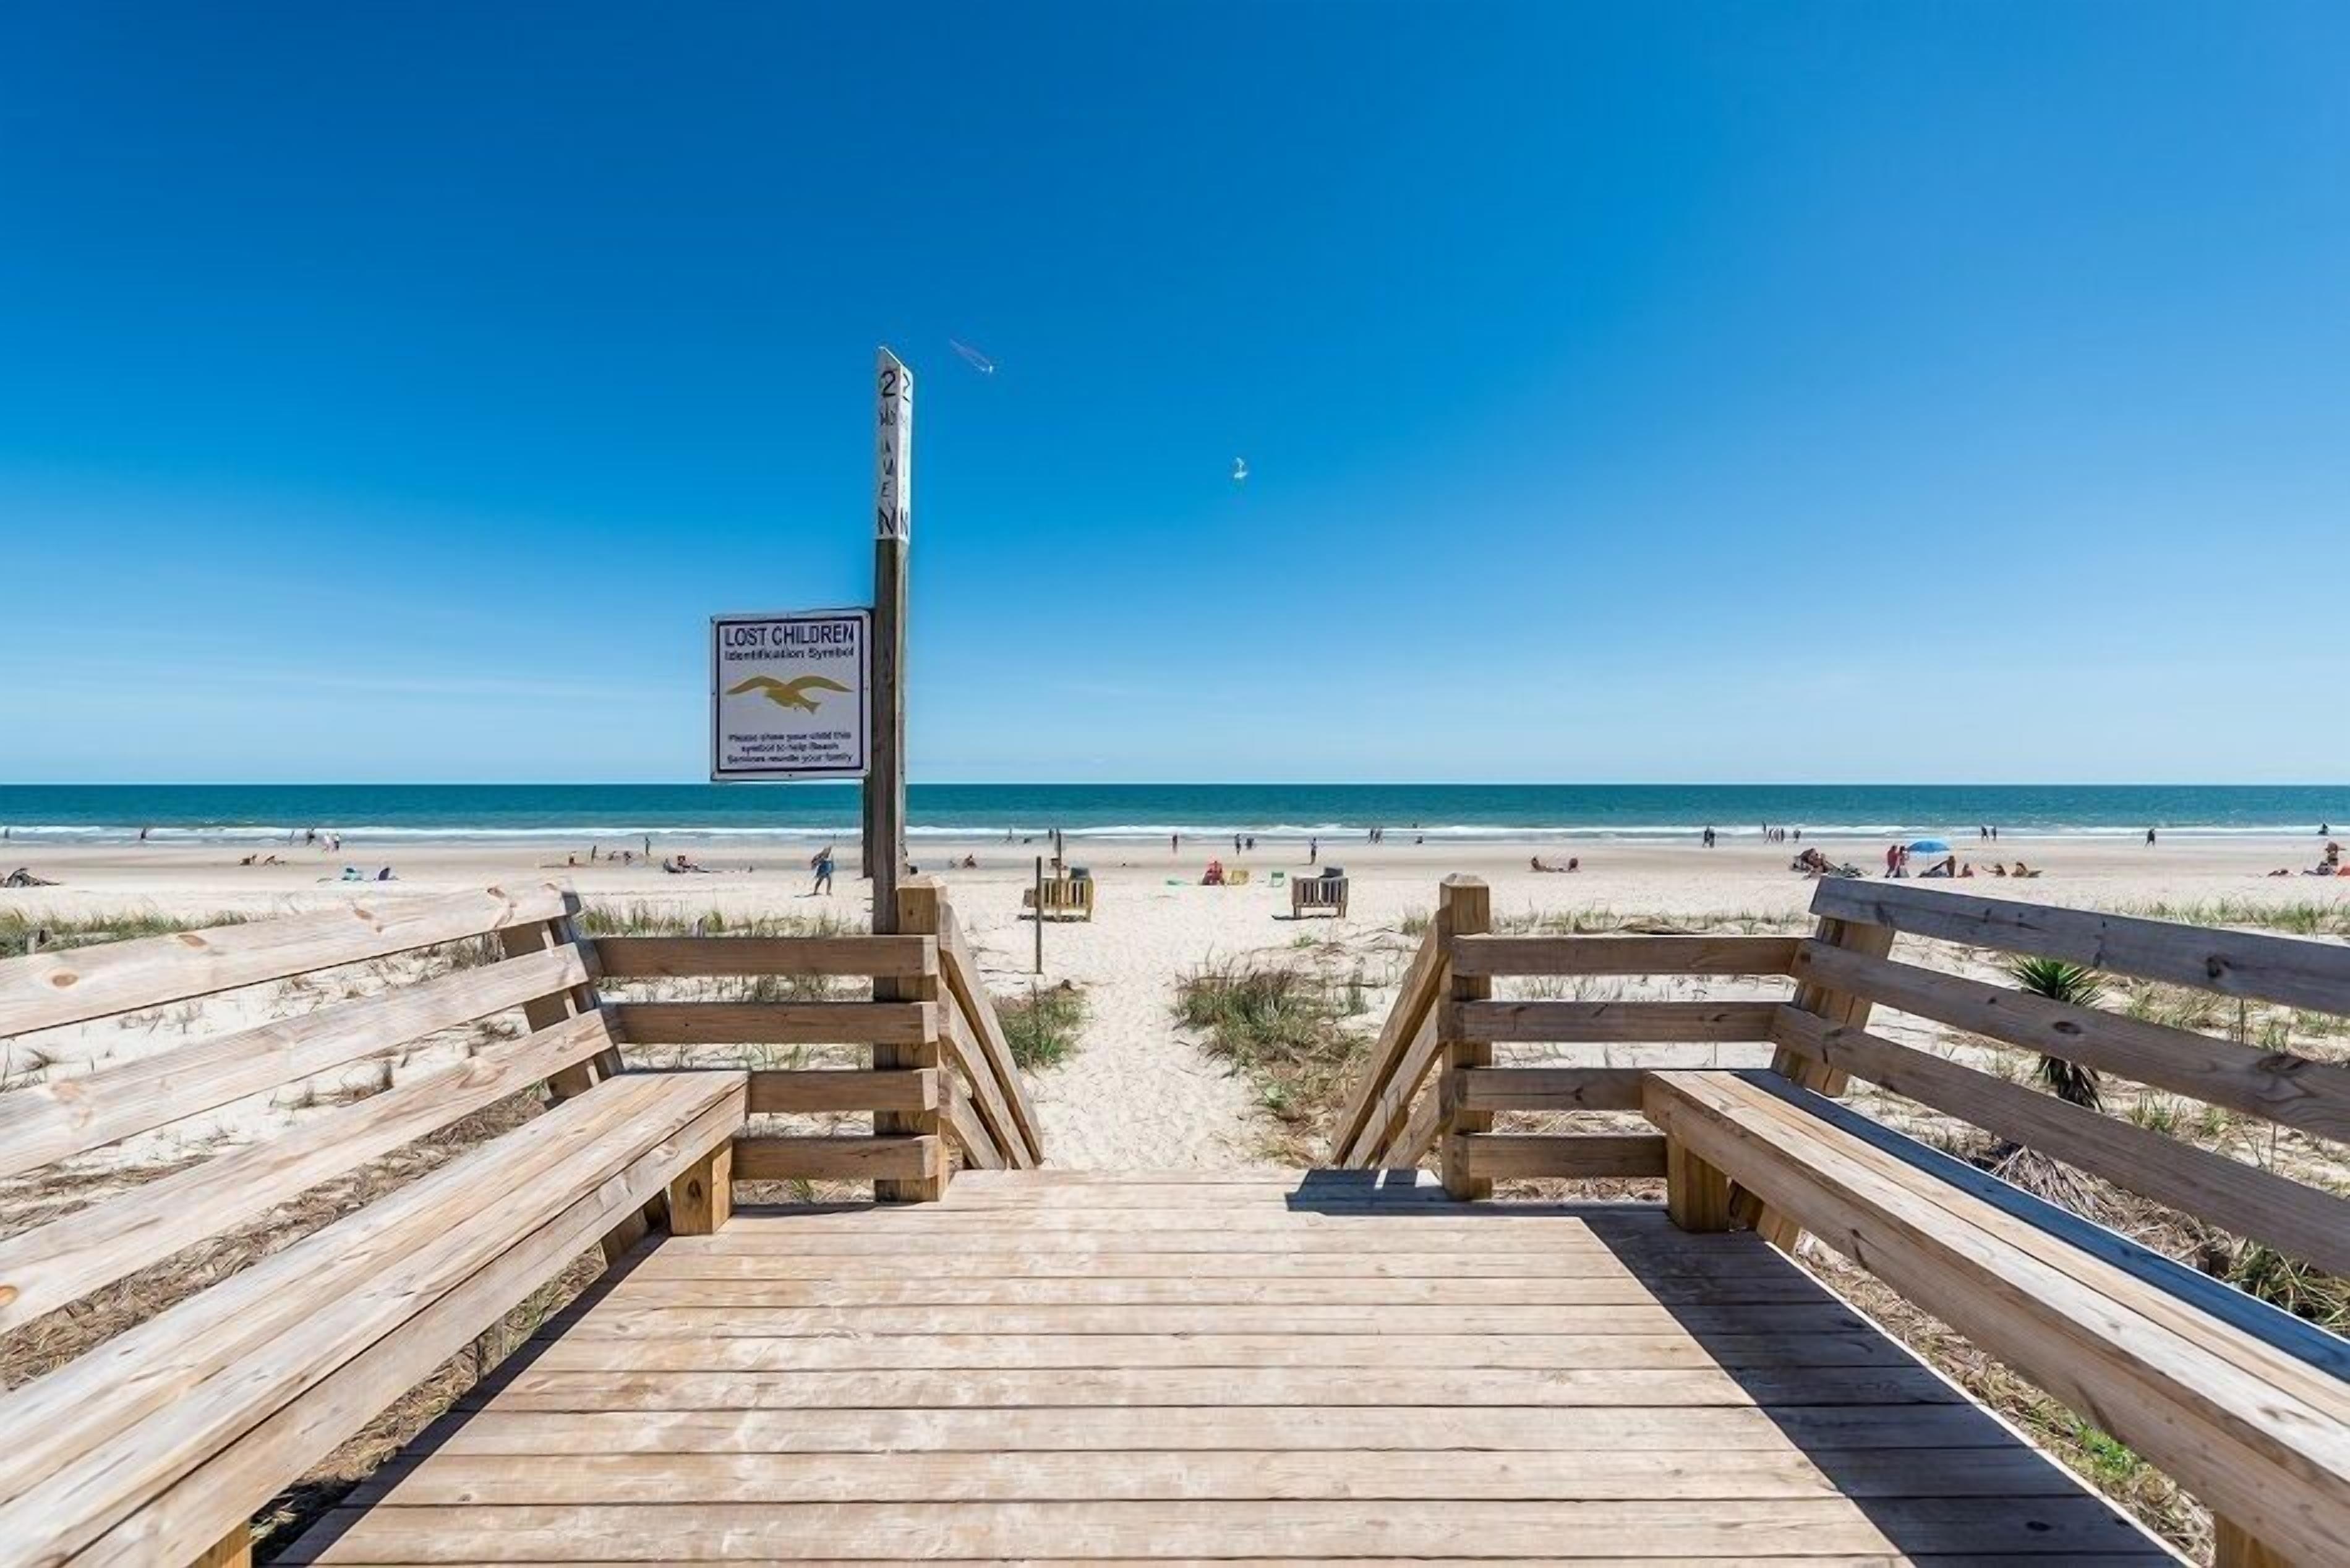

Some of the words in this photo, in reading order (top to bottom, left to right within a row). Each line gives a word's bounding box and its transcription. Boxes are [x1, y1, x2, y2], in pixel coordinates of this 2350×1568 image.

[881, 370, 896, 398] 2
[878, 506, 896, 535] N
[724, 627, 767, 646] LOST
[772, 623, 854, 646] CHILDREN
[725, 649, 805, 660] Identification
[809, 647, 854, 660] Symbol
